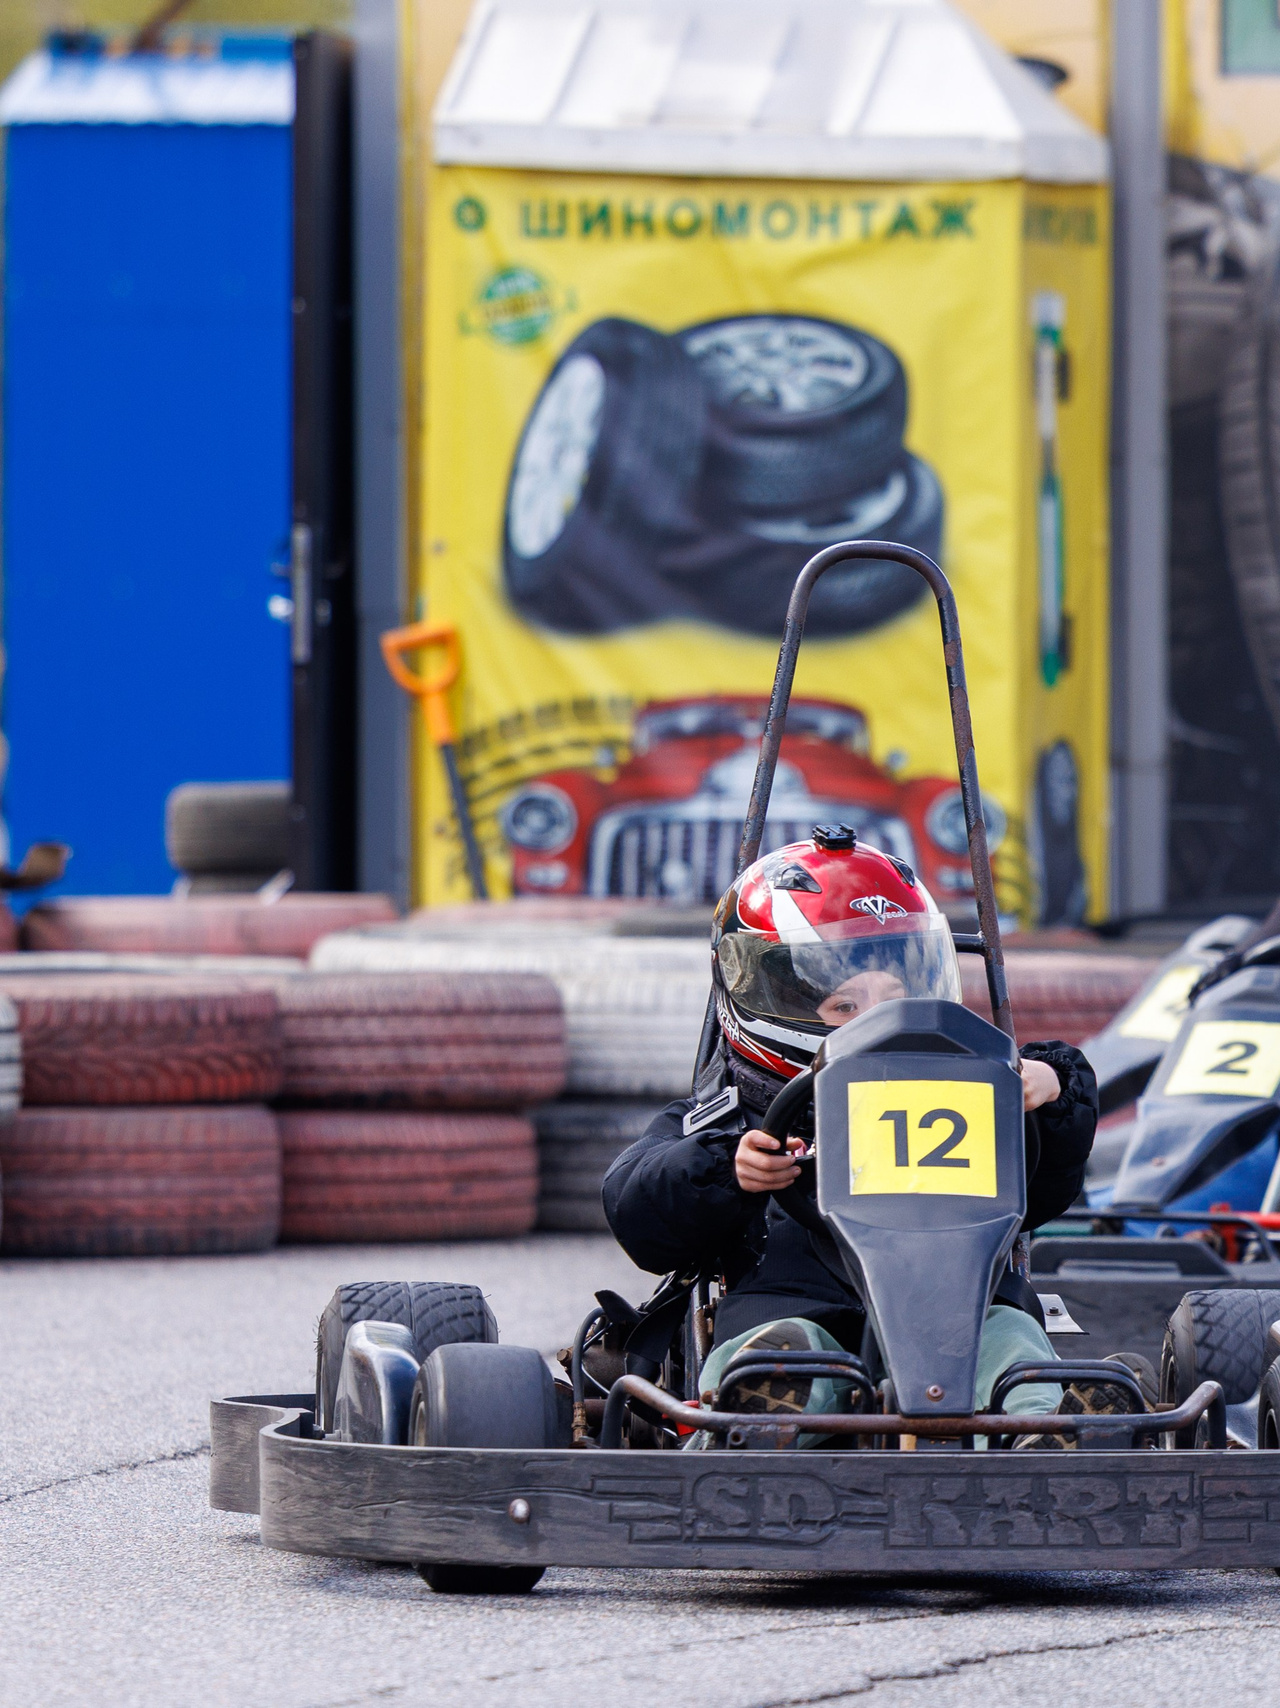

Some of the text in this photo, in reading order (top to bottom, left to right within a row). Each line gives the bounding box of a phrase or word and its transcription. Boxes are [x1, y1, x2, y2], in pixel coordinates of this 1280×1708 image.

[521, 202, 976, 240] ШИНОМОНТАЖ
[1204, 1040, 1259, 1075] 2
[878, 1108, 970, 1168] 12
